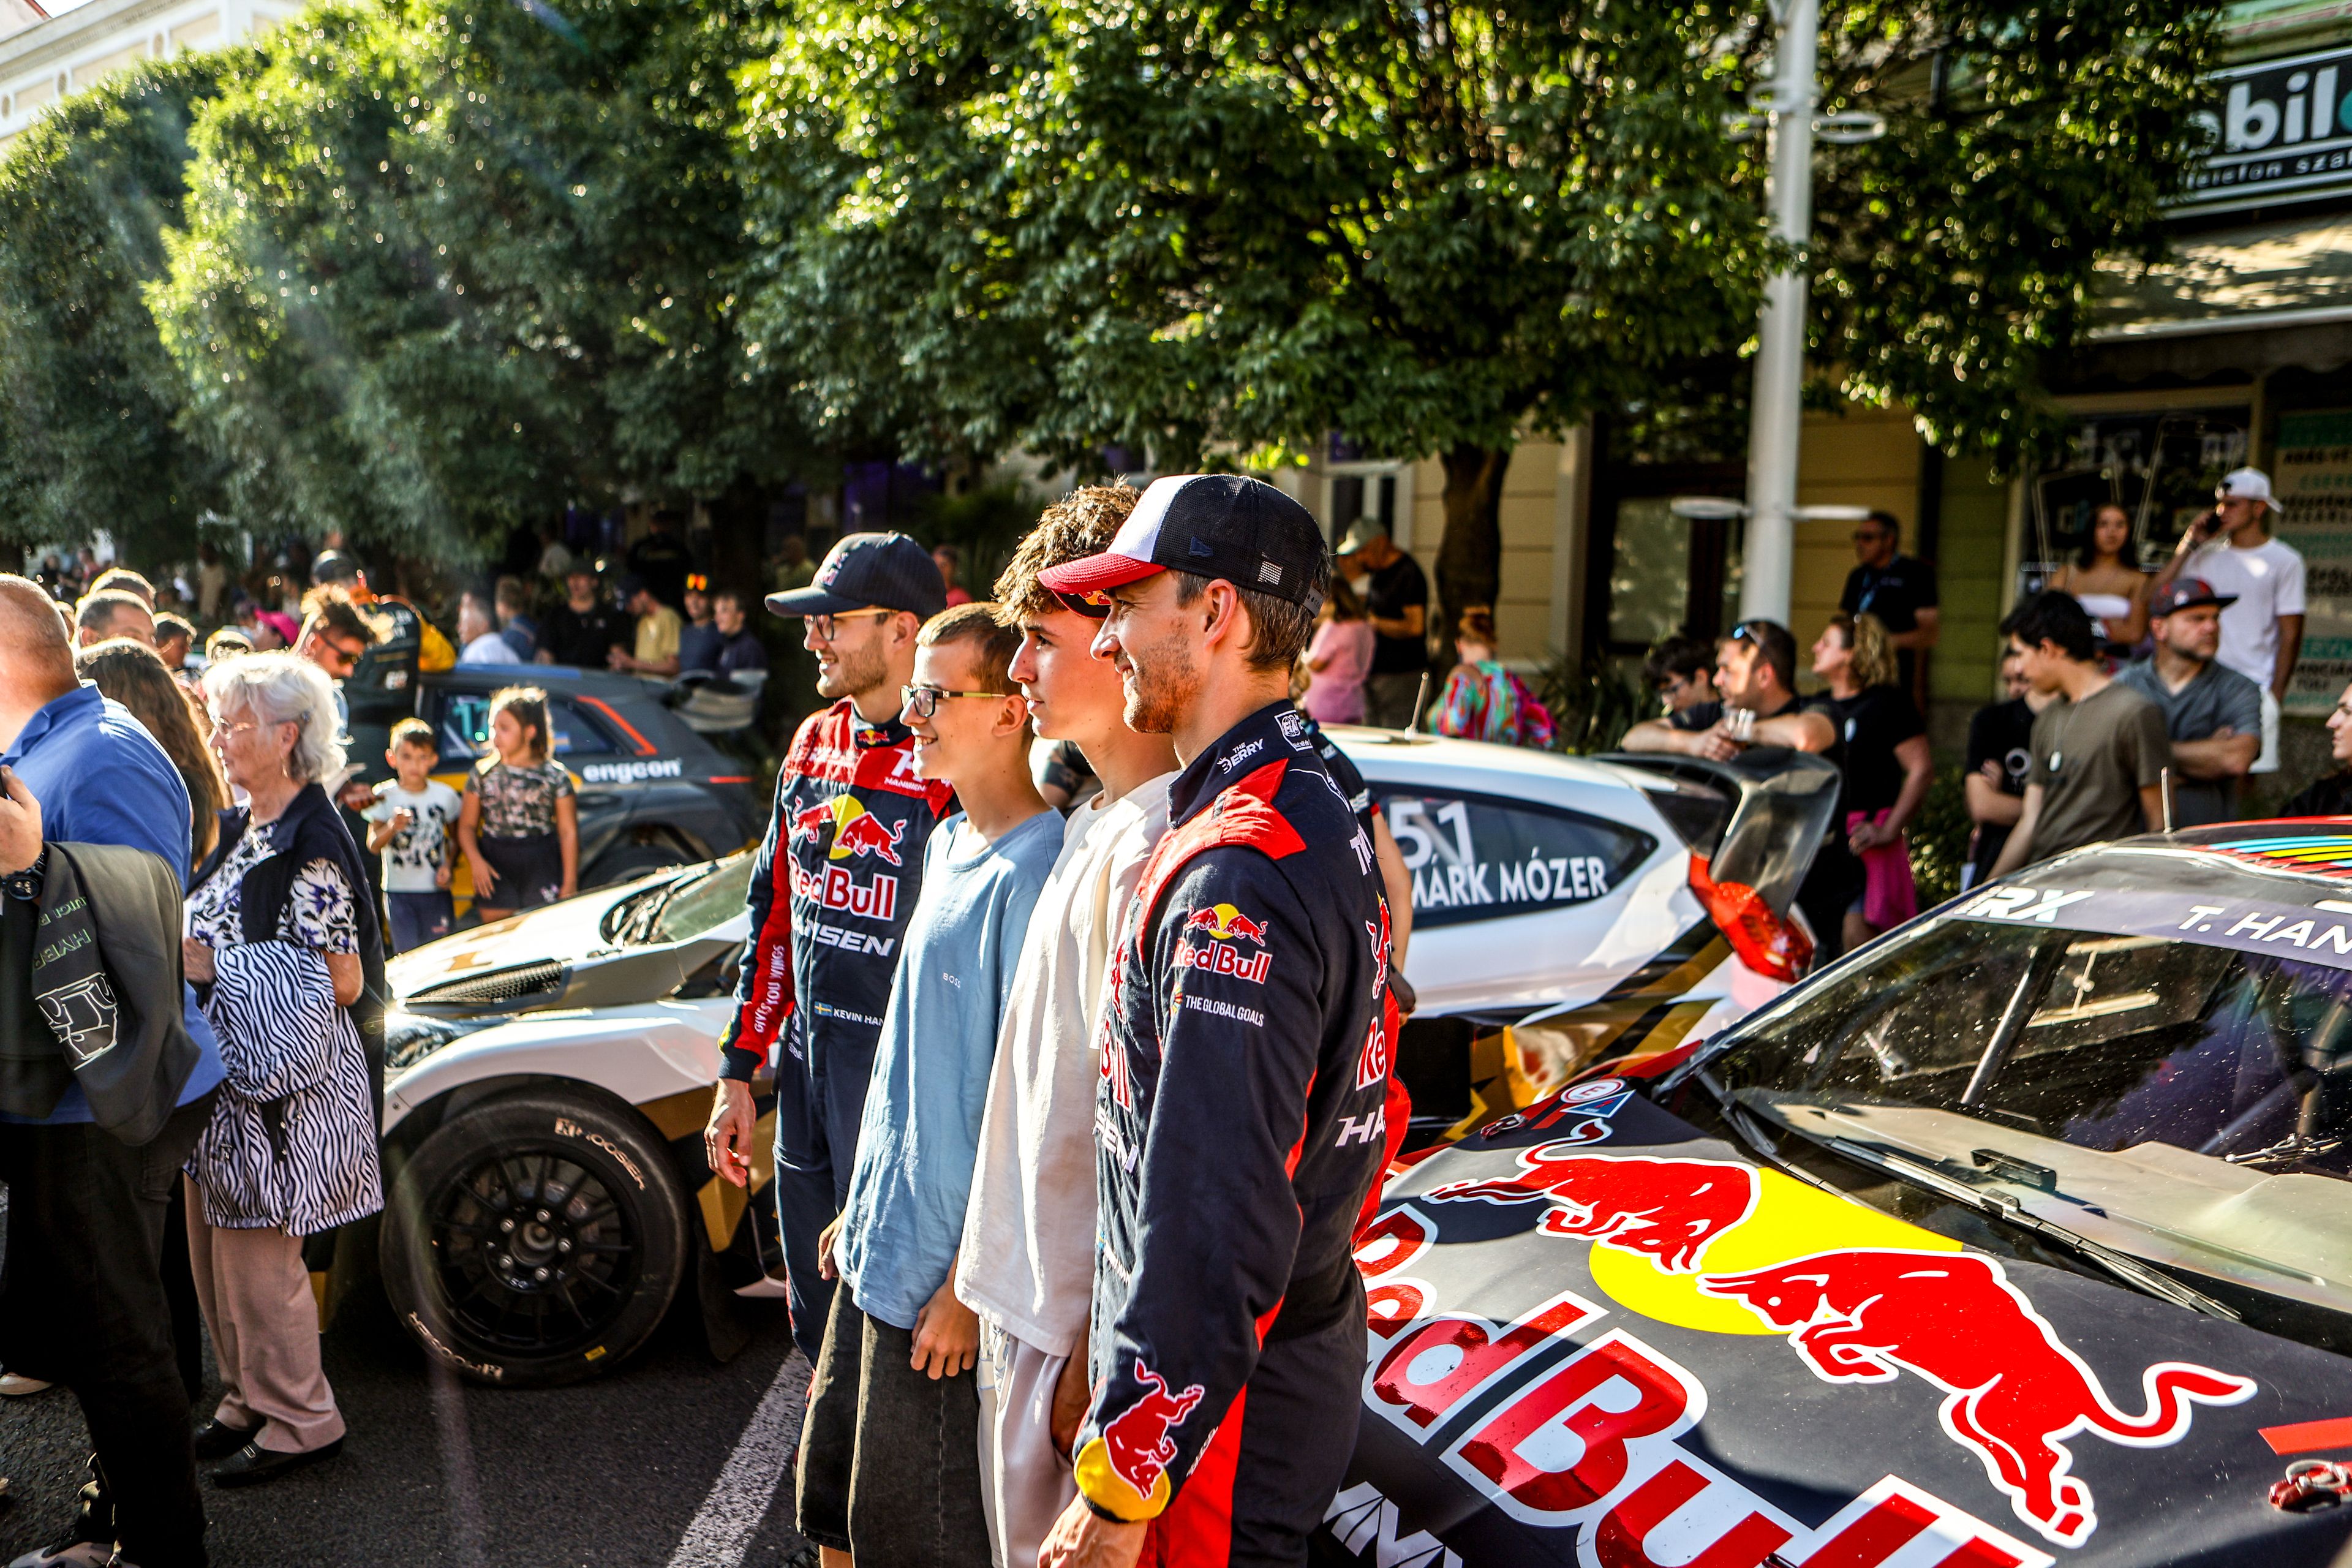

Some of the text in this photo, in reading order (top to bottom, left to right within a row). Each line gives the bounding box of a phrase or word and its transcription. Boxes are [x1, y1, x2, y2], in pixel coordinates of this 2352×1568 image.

[1216, 737, 1264, 775] BERRY
[1232, 741, 1246, 753] THE
[582, 759, 679, 783] engcon
[1389, 800, 1476, 870] 51
[821, 864, 899, 922] Bull
[1498, 845, 1609, 904] MÓZER
[2177, 904, 2352, 956] T. HAN
[943, 972, 961, 989] BOSS
[1212, 944, 1273, 985] Bull
[766, 981, 782, 1005] YOU
[1185, 995, 1265, 1028] THE GLOBAL GOALS
[833, 1008, 863, 1023] KEVIN
[1438, 1327, 2056, 1568] Bul
